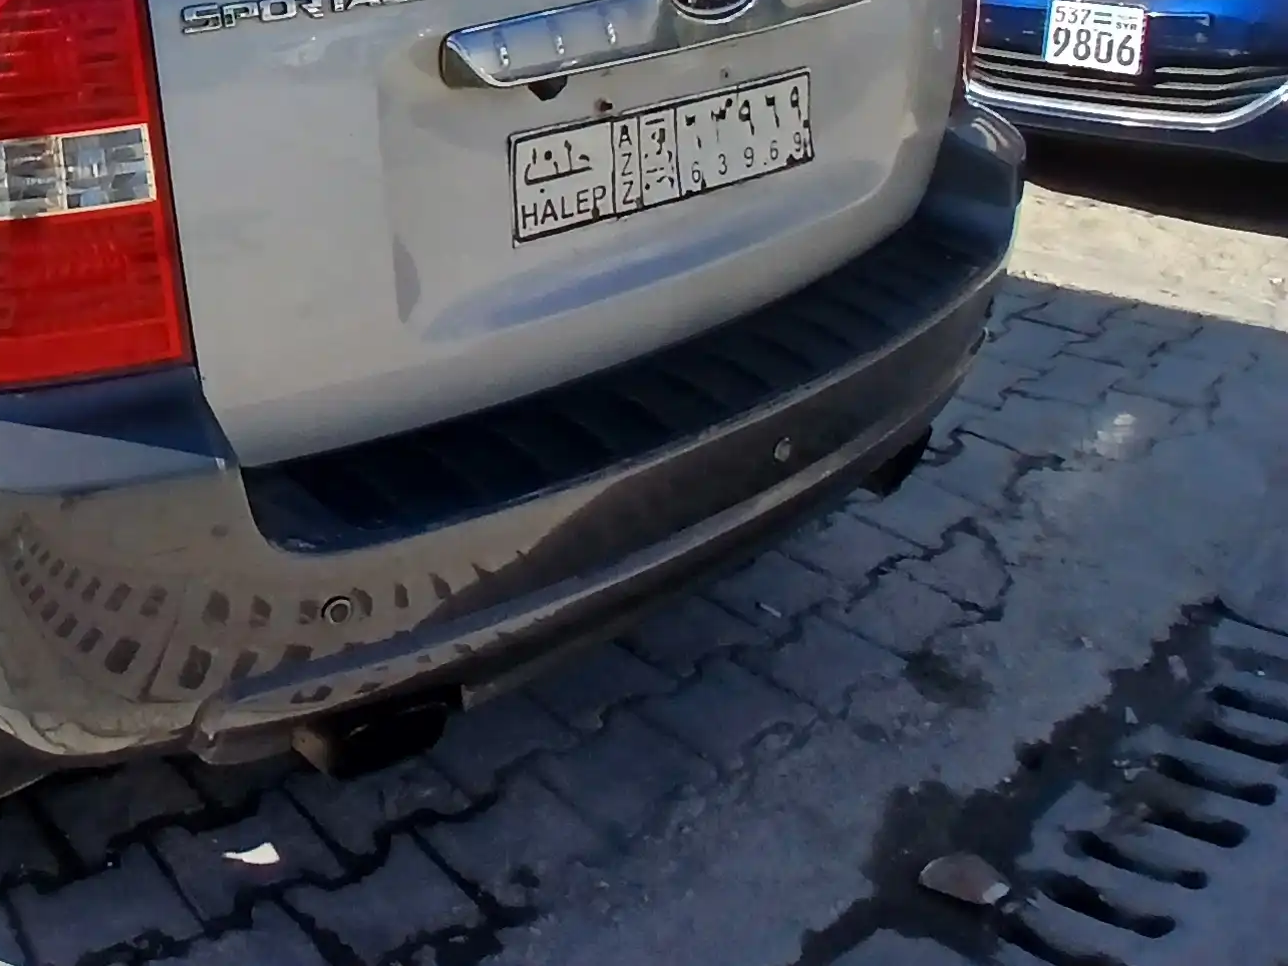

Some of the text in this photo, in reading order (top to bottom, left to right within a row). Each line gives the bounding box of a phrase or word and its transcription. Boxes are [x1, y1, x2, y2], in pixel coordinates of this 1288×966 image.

[1055, 5, 1091, 25] 537
[1115, 21, 1138, 31] SYR
[1053, 26, 1136, 66] 9806
[691, 131, 803, 184] 63969
[521, 185, 607, 229] HALEP
